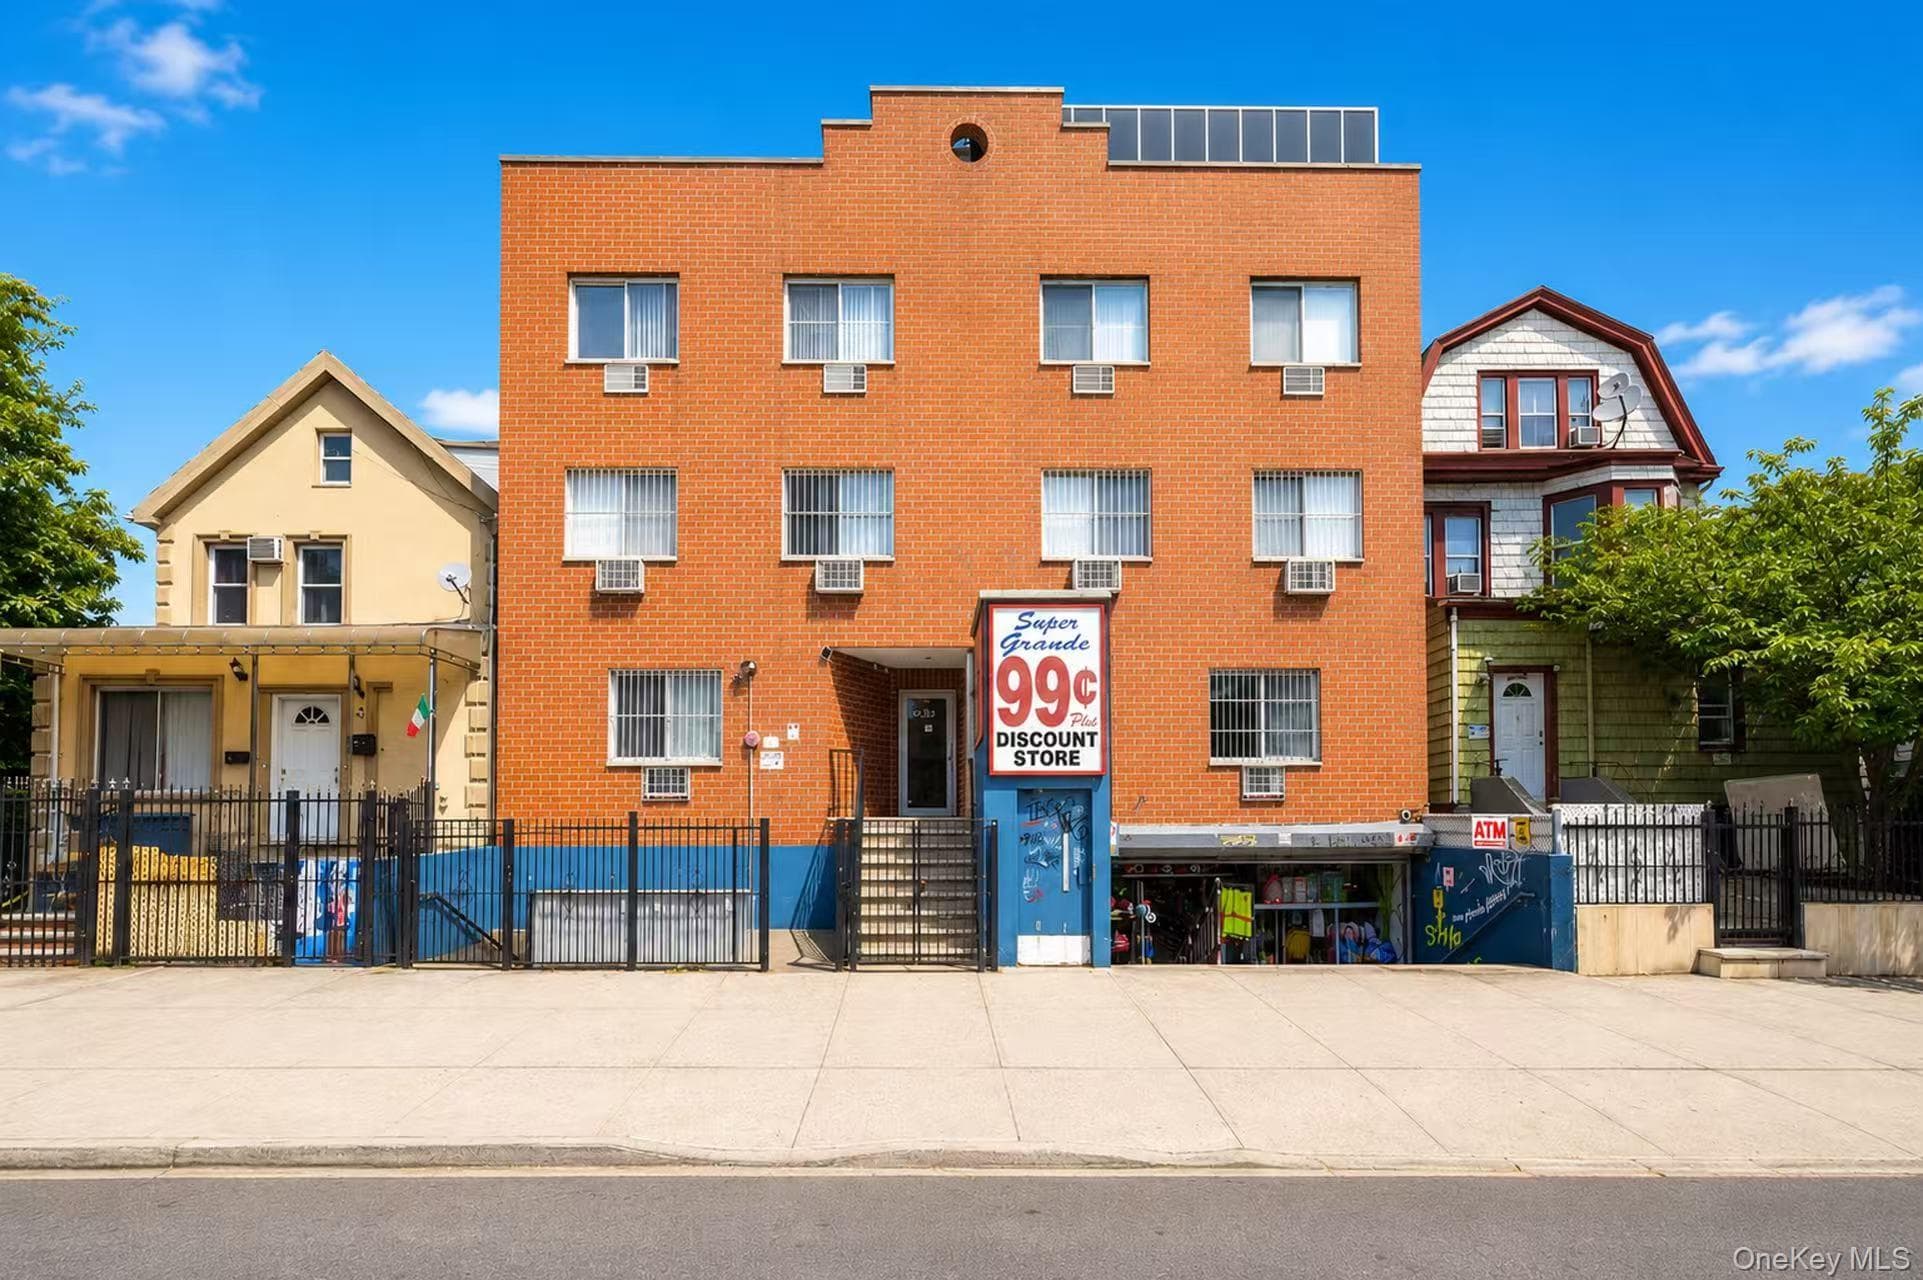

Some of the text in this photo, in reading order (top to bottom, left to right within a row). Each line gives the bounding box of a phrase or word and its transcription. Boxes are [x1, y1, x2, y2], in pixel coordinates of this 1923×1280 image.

[1014, 611, 1078, 635] Super
[1000, 632, 1090, 657] Grande
[996, 655, 1097, 727] 99¢
[1070, 713, 1097, 727] Plus
[996, 731, 1098, 747] DISCOUNT
[1014, 750, 1080, 766] STORE
[1474, 821, 1506, 839] ATM
